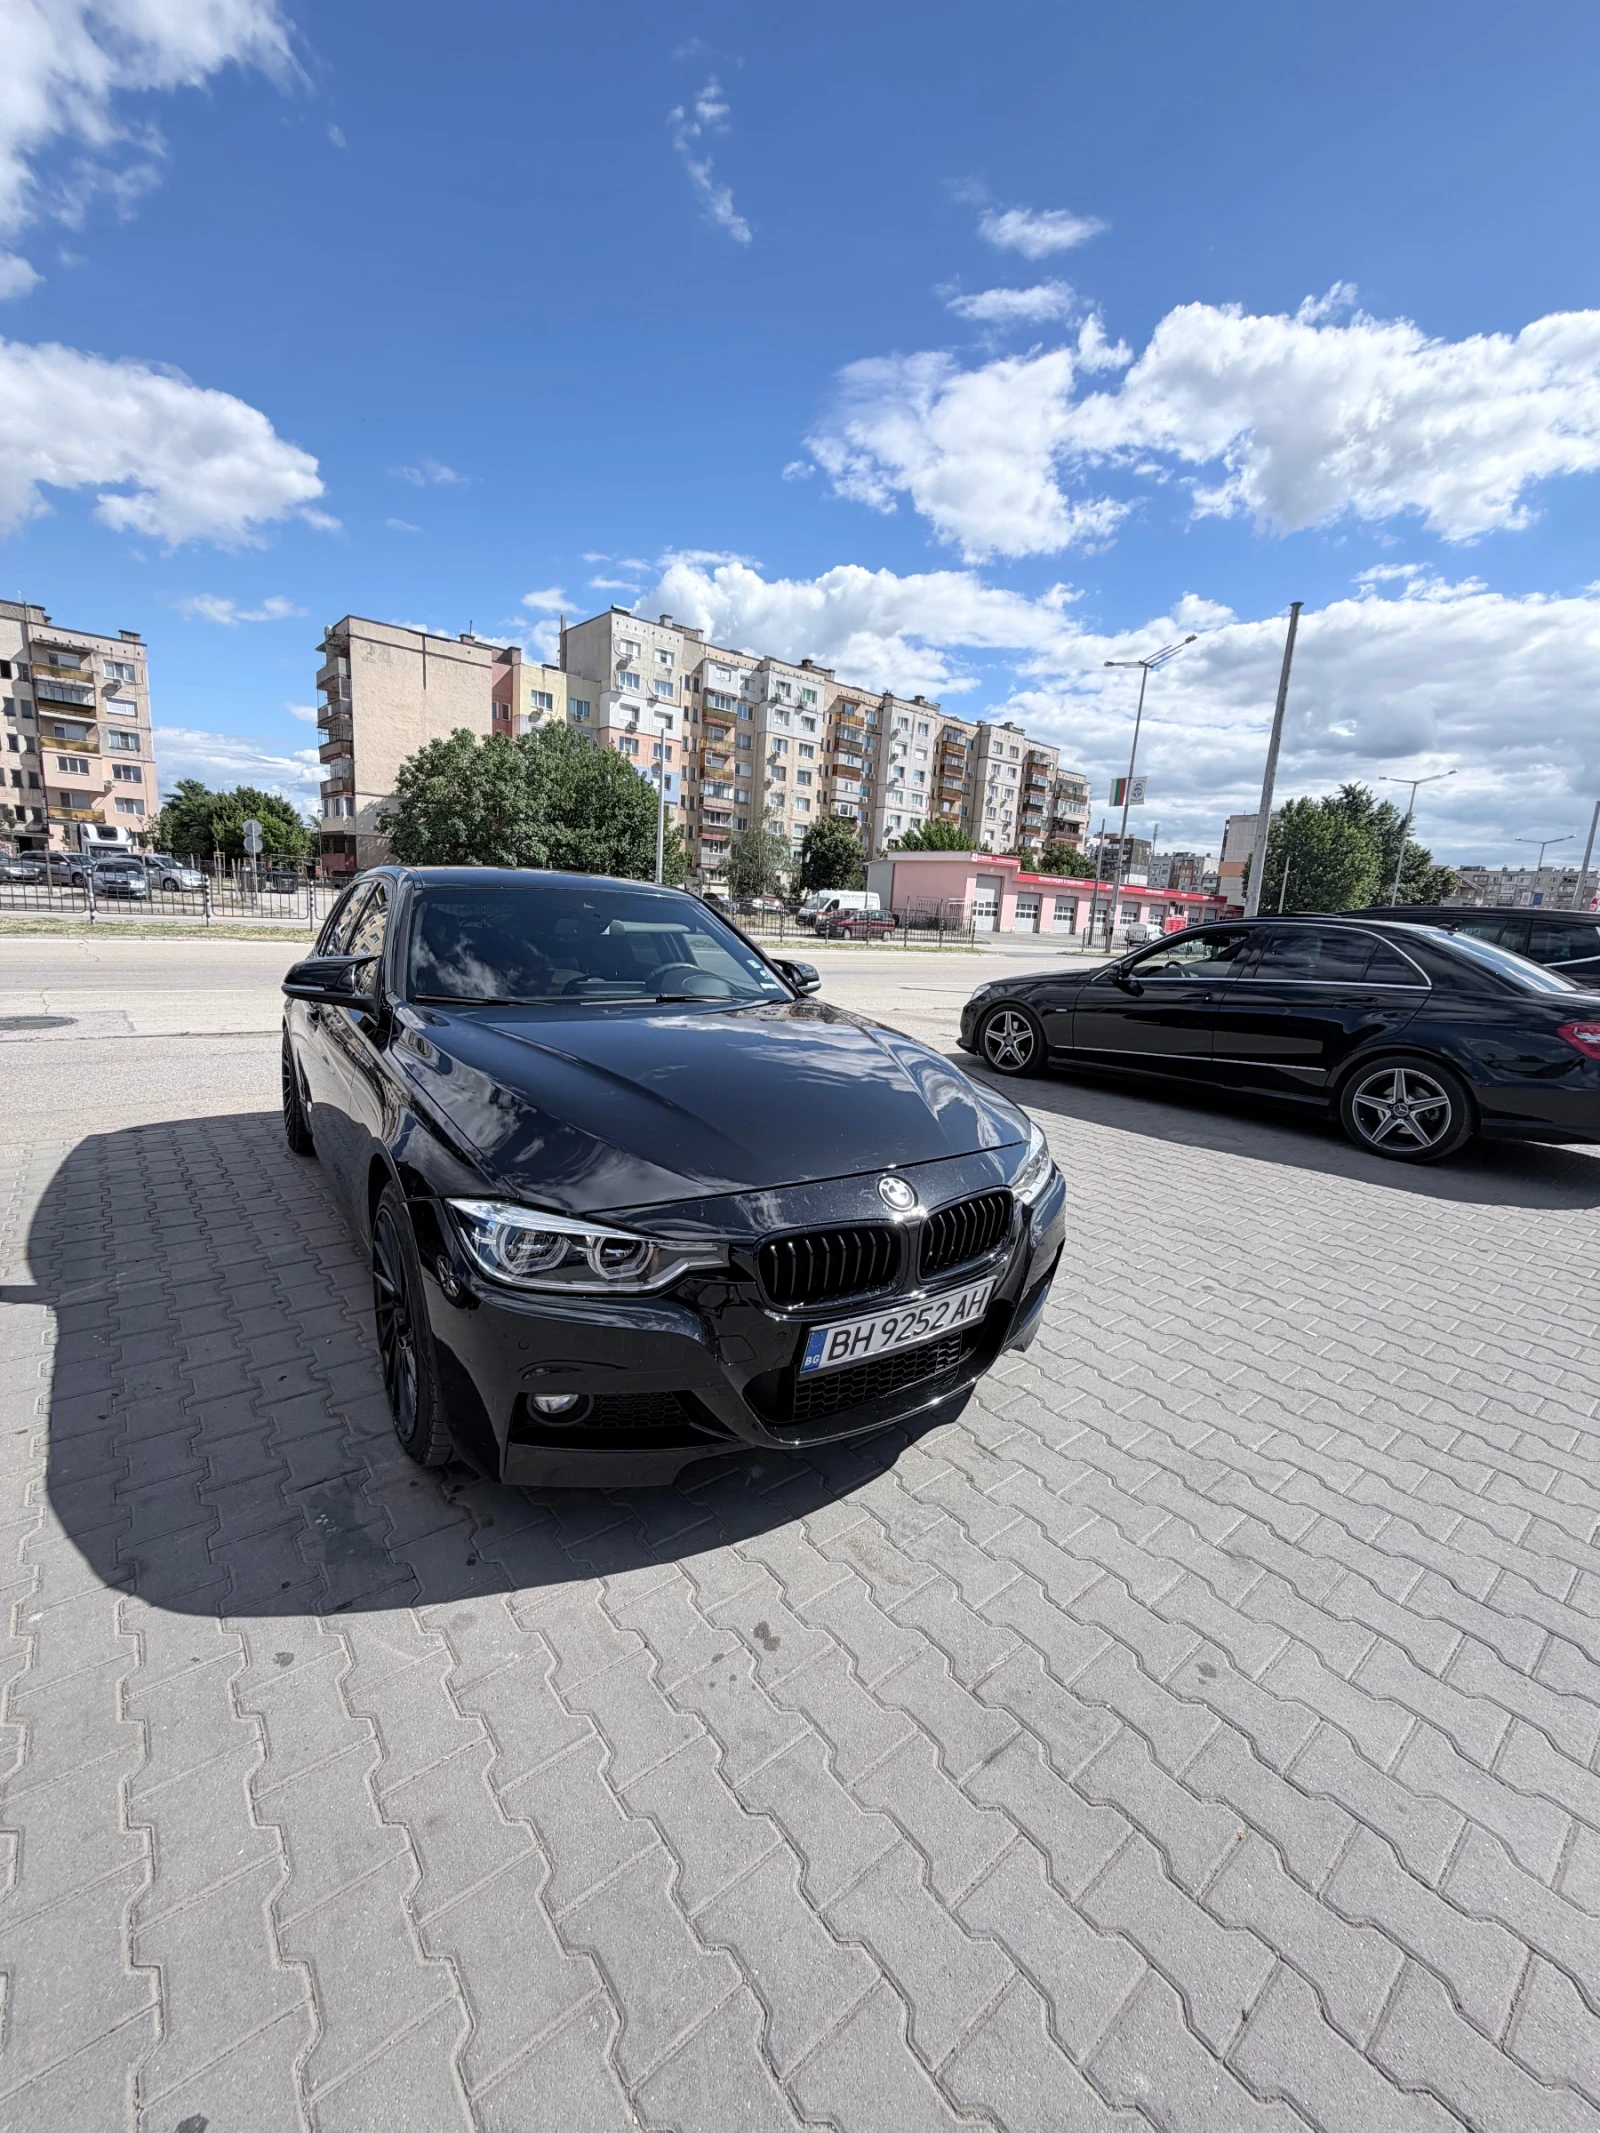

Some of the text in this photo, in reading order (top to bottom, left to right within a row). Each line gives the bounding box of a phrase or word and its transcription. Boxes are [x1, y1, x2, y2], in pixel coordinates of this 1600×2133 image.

[827, 1286, 988, 1361] BH 9252 AH
[804, 1354, 821, 1366] BG
